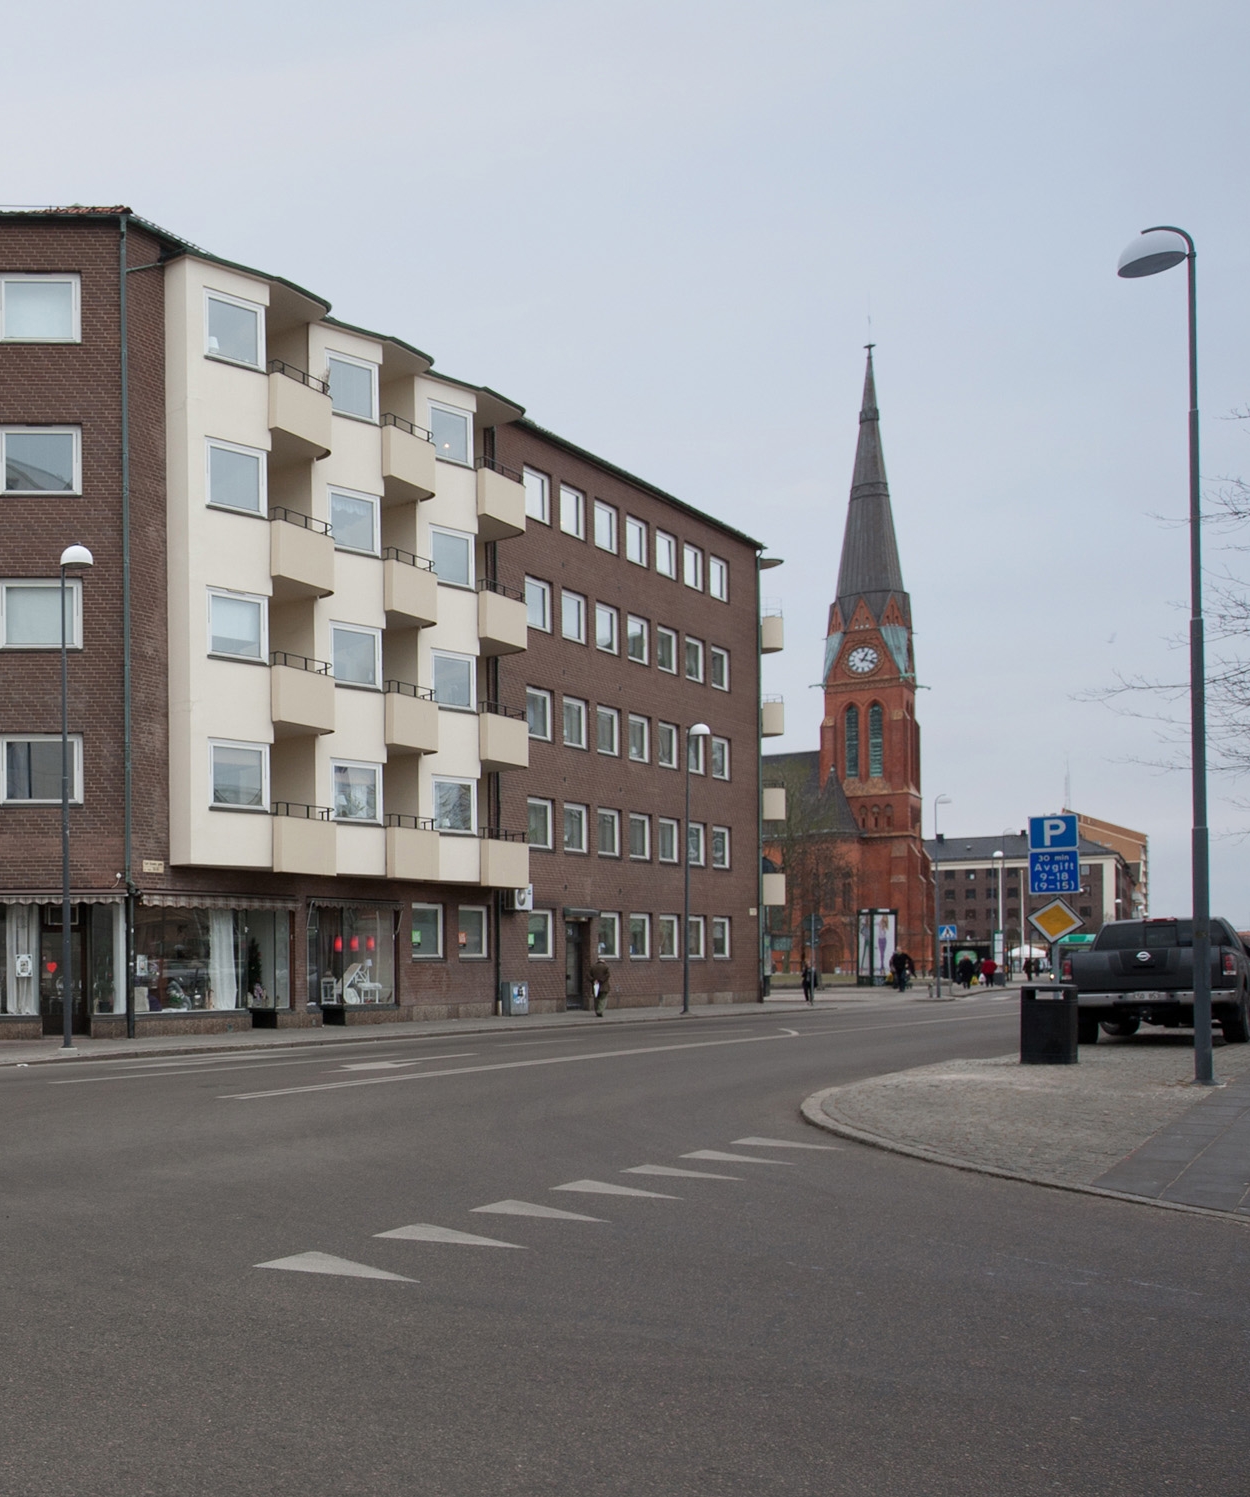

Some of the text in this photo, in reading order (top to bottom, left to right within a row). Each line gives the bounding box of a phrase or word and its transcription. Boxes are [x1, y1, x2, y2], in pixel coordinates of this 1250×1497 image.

[1044, 819, 1066, 846] P
[1034, 862, 1074, 873] Avgift
[1039, 872, 1069, 881] 9-18
[1034, 881, 1075, 891] (9-15)
